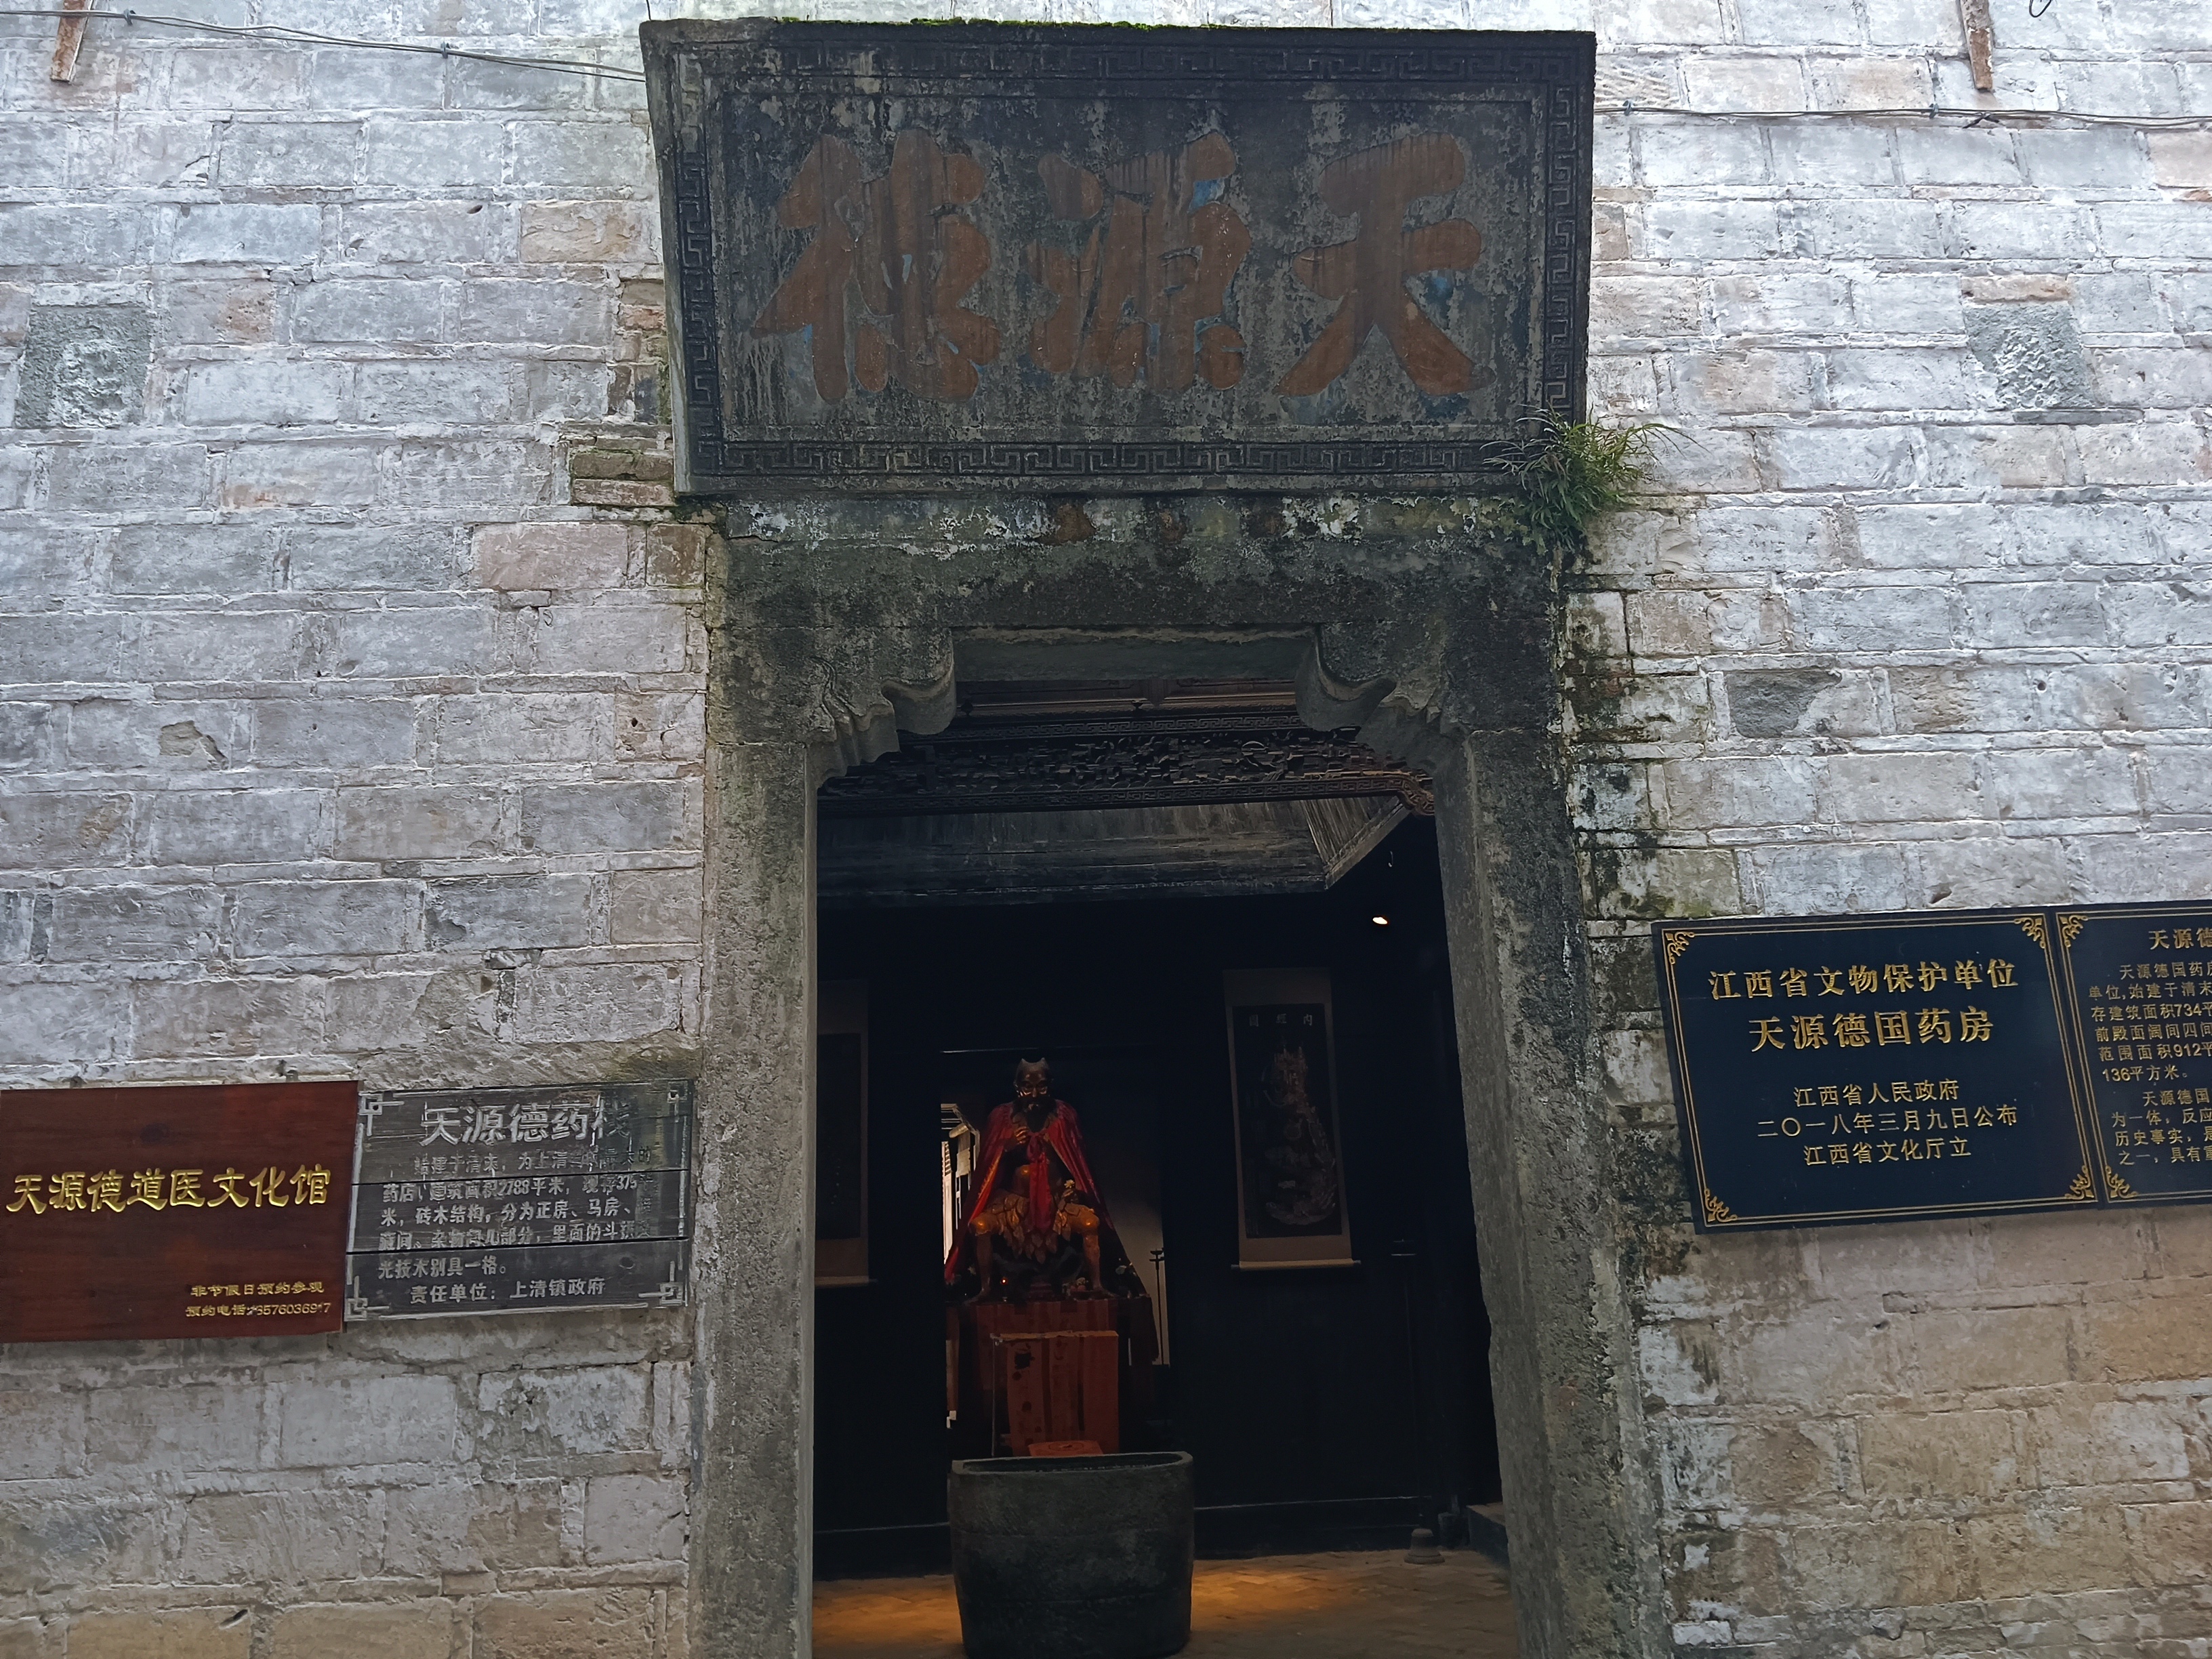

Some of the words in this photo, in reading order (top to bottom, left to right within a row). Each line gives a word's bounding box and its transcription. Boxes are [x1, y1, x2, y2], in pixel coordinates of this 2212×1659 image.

[2148, 927, 2212, 950] 天源德
[1707, 958, 2019, 1000] 江西省文物保护单位
[2091, 1001, 2212, 1022] 存建筑面积734平
[1748, 1005, 1994, 1052] 天源德国药房
[2098, 1041, 2212, 1062] 范围面积912平
[1793, 1078, 1959, 1107] 江西省人民政府
[1803, 1135, 1971, 1166] 江西省文化厅立
[6, 1163, 331, 1214] 天源德道医文化馆
[190, 1281, 325, 1297] 非节假日预约参观
[410, 1277, 605, 1305] 责任单位：上清镇政府
